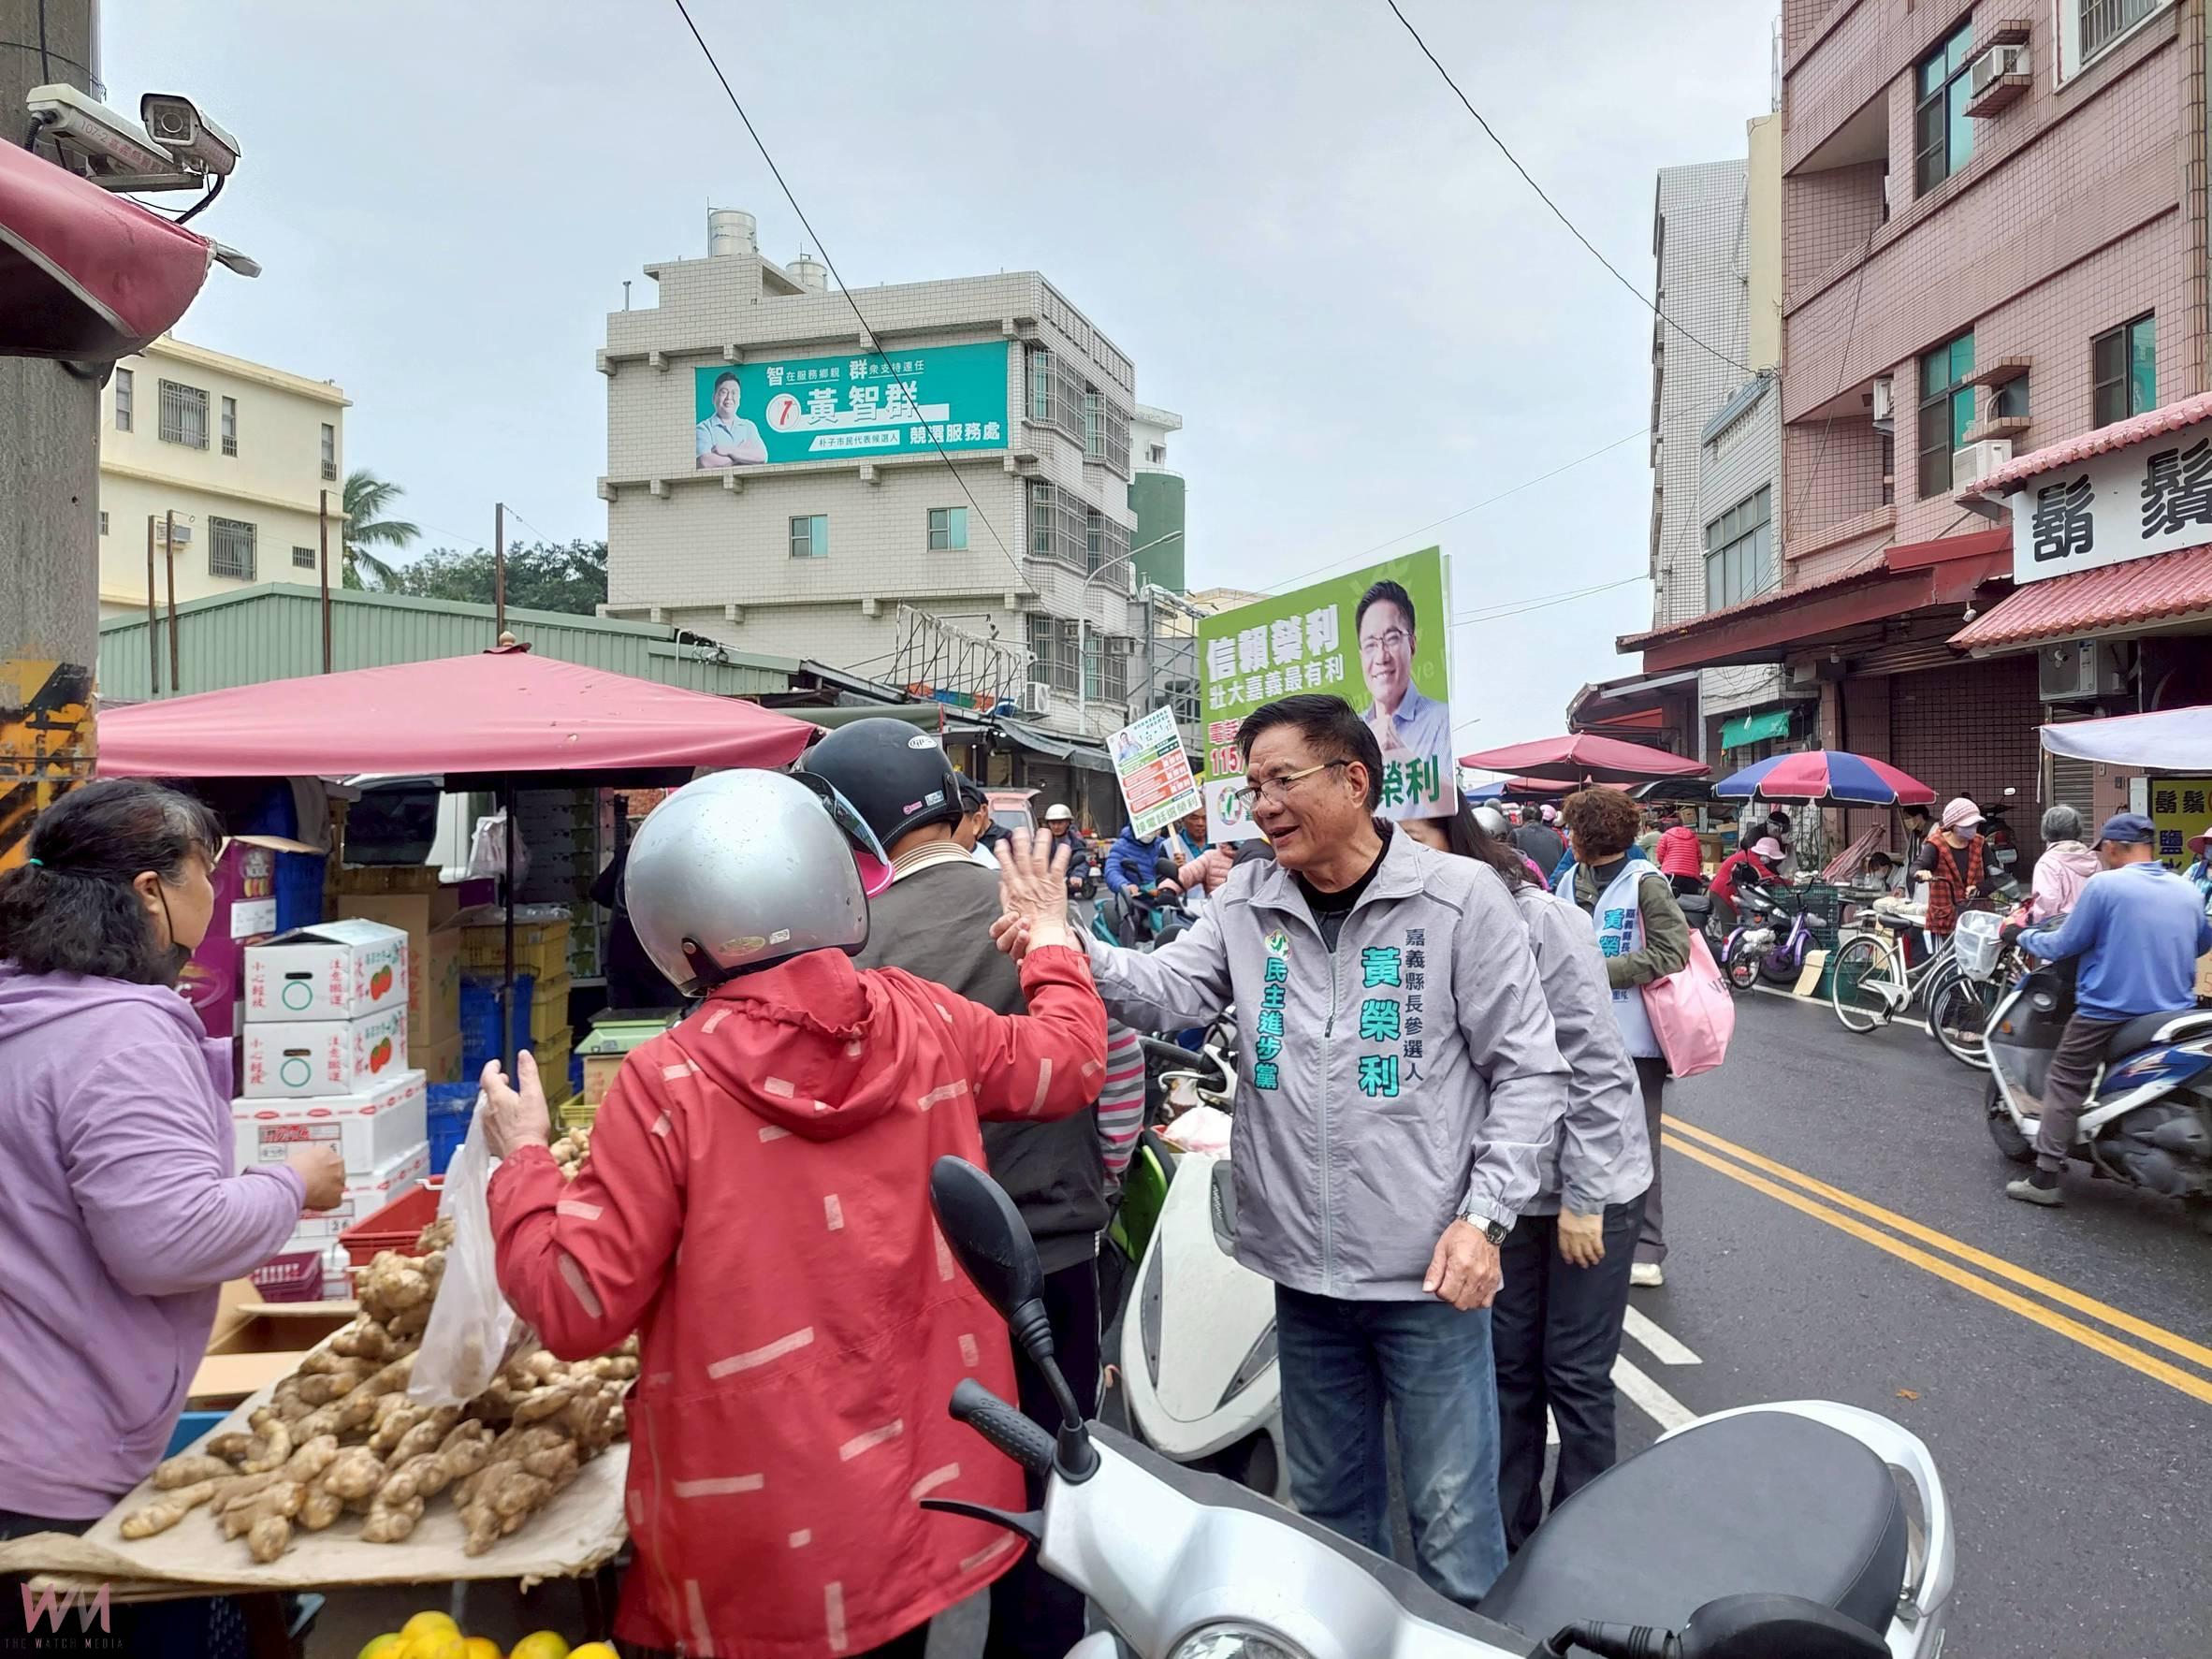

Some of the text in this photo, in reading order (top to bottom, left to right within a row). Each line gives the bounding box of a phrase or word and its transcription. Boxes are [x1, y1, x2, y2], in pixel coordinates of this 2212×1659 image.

[807, 380, 919, 425] 黃智群
[910, 421, 1000, 444] 競選服務處
[819, 434, 898, 447] 朴子市民代表候選人
[1206, 604, 1340, 683] 信賴榮利
[1209, 653, 1345, 710] 壯大嘉義最有利
[1254, 957, 1288, 1091] 民主進步黨
[1359, 947, 1402, 1098] 黃榮利
[1403, 927, 1426, 1082] 嘉義縣長參選人
